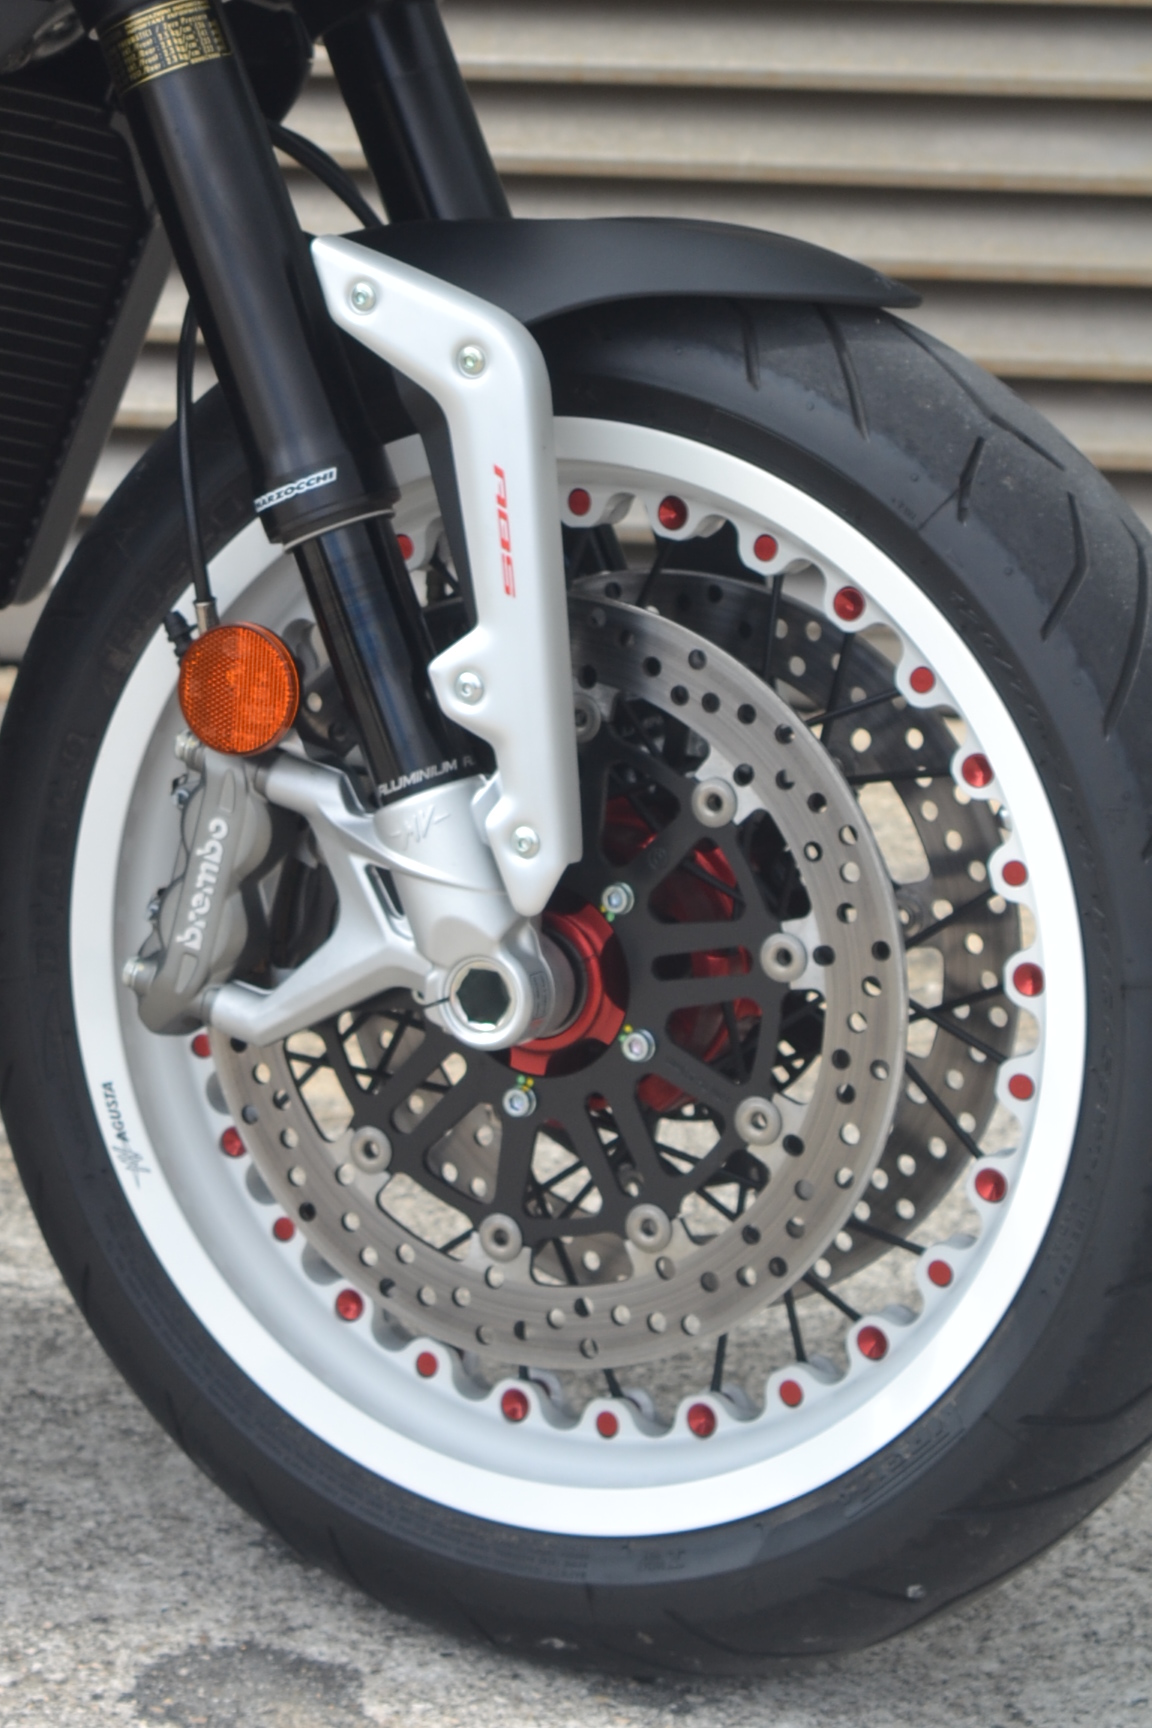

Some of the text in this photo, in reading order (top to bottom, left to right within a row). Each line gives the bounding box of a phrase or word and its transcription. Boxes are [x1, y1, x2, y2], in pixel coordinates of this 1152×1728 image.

[493, 464, 515, 597] ABS
[378, 759, 458, 796] ALUMINIUM
[176, 817, 228, 950] brembo
[102, 1081, 130, 1143] AGUSTA
